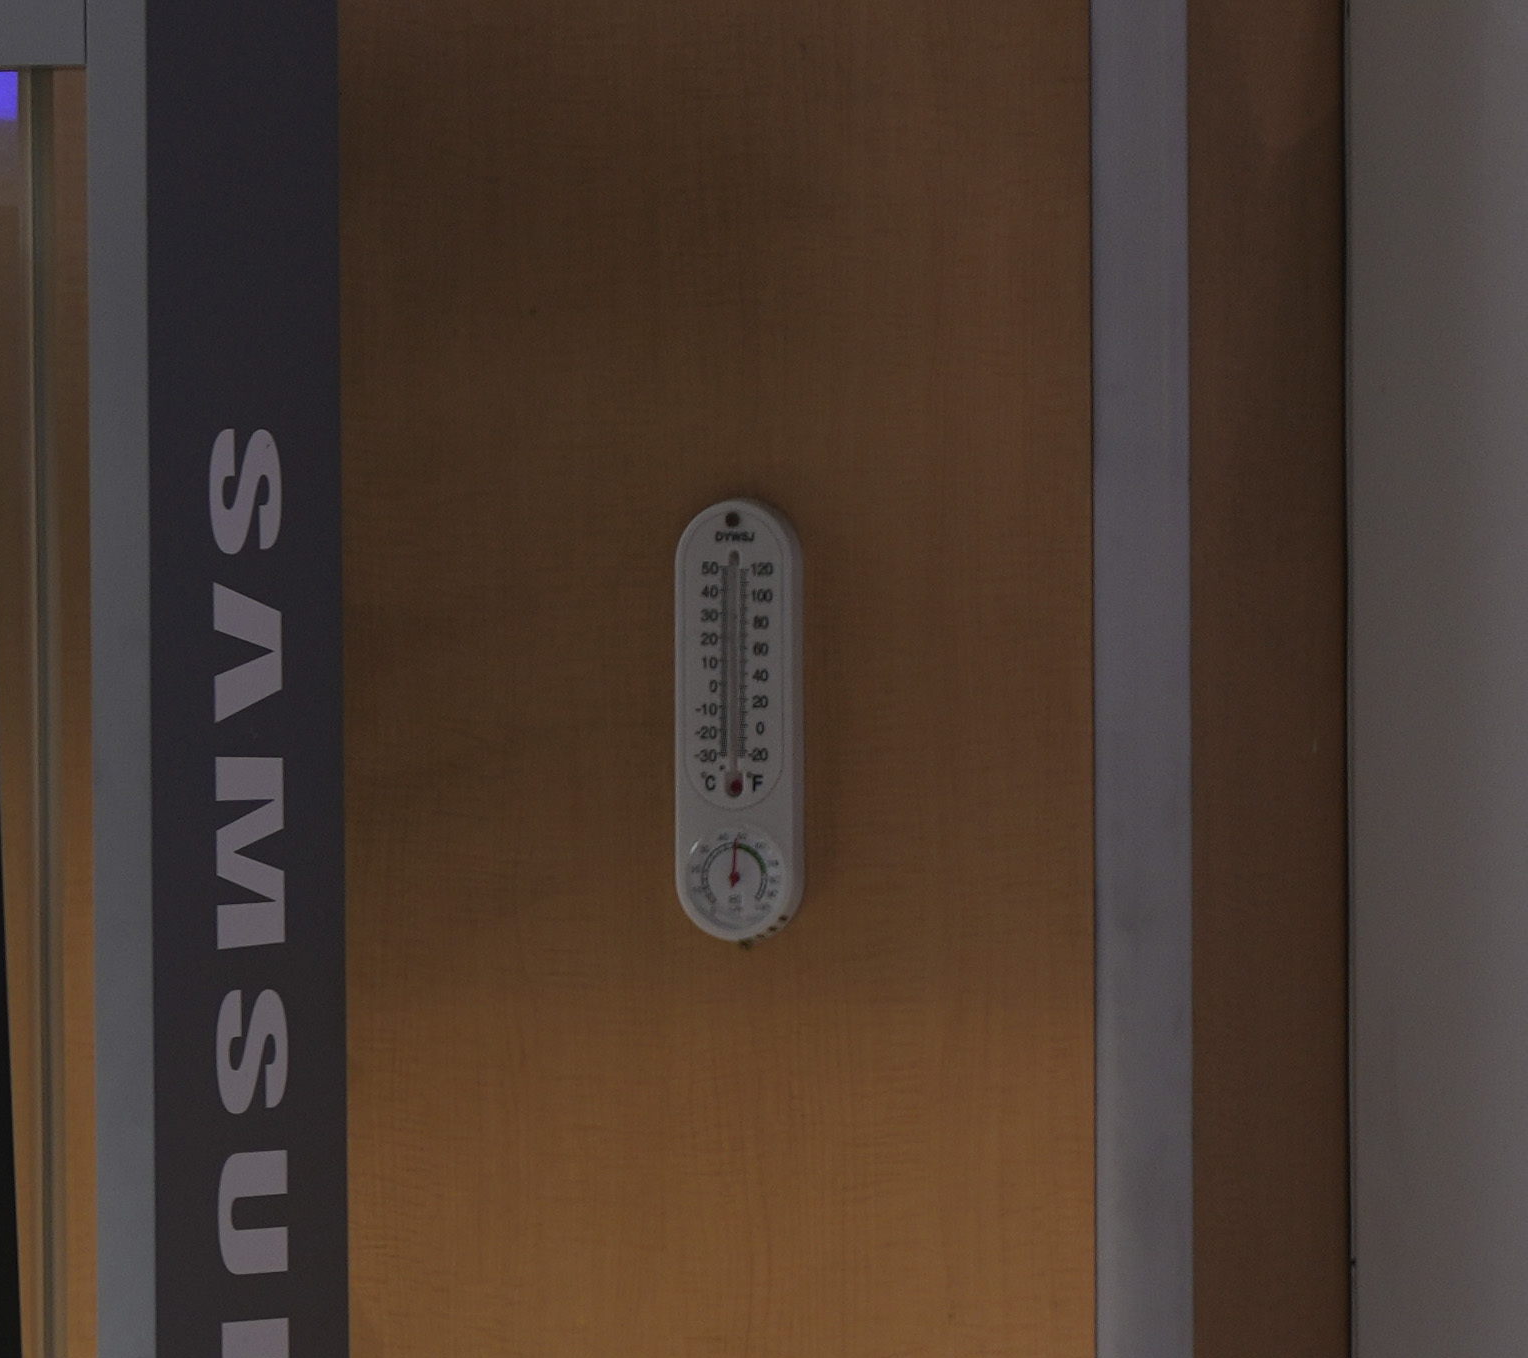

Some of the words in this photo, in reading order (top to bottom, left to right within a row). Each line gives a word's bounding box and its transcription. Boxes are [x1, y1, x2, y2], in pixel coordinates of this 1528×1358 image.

[702, 561, 719, 575] 50
[752, 562, 773, 576] 120
[701, 584, 718, 598] 40
[752, 588, 773, 603] 100
[701, 608, 718, 622] 30
[700, 632, 718, 646] 20
[702, 657, 718, 669] 10
[753, 668, 769, 682] 40
[752, 695, 769, 708] 20
[695, 703, 717, 716] -10
[695, 726, 717, 740] -20
[756, 722, 765, 736] 0
[694, 749, 717, 762] -30
[748, 748, 769, 762] -20
